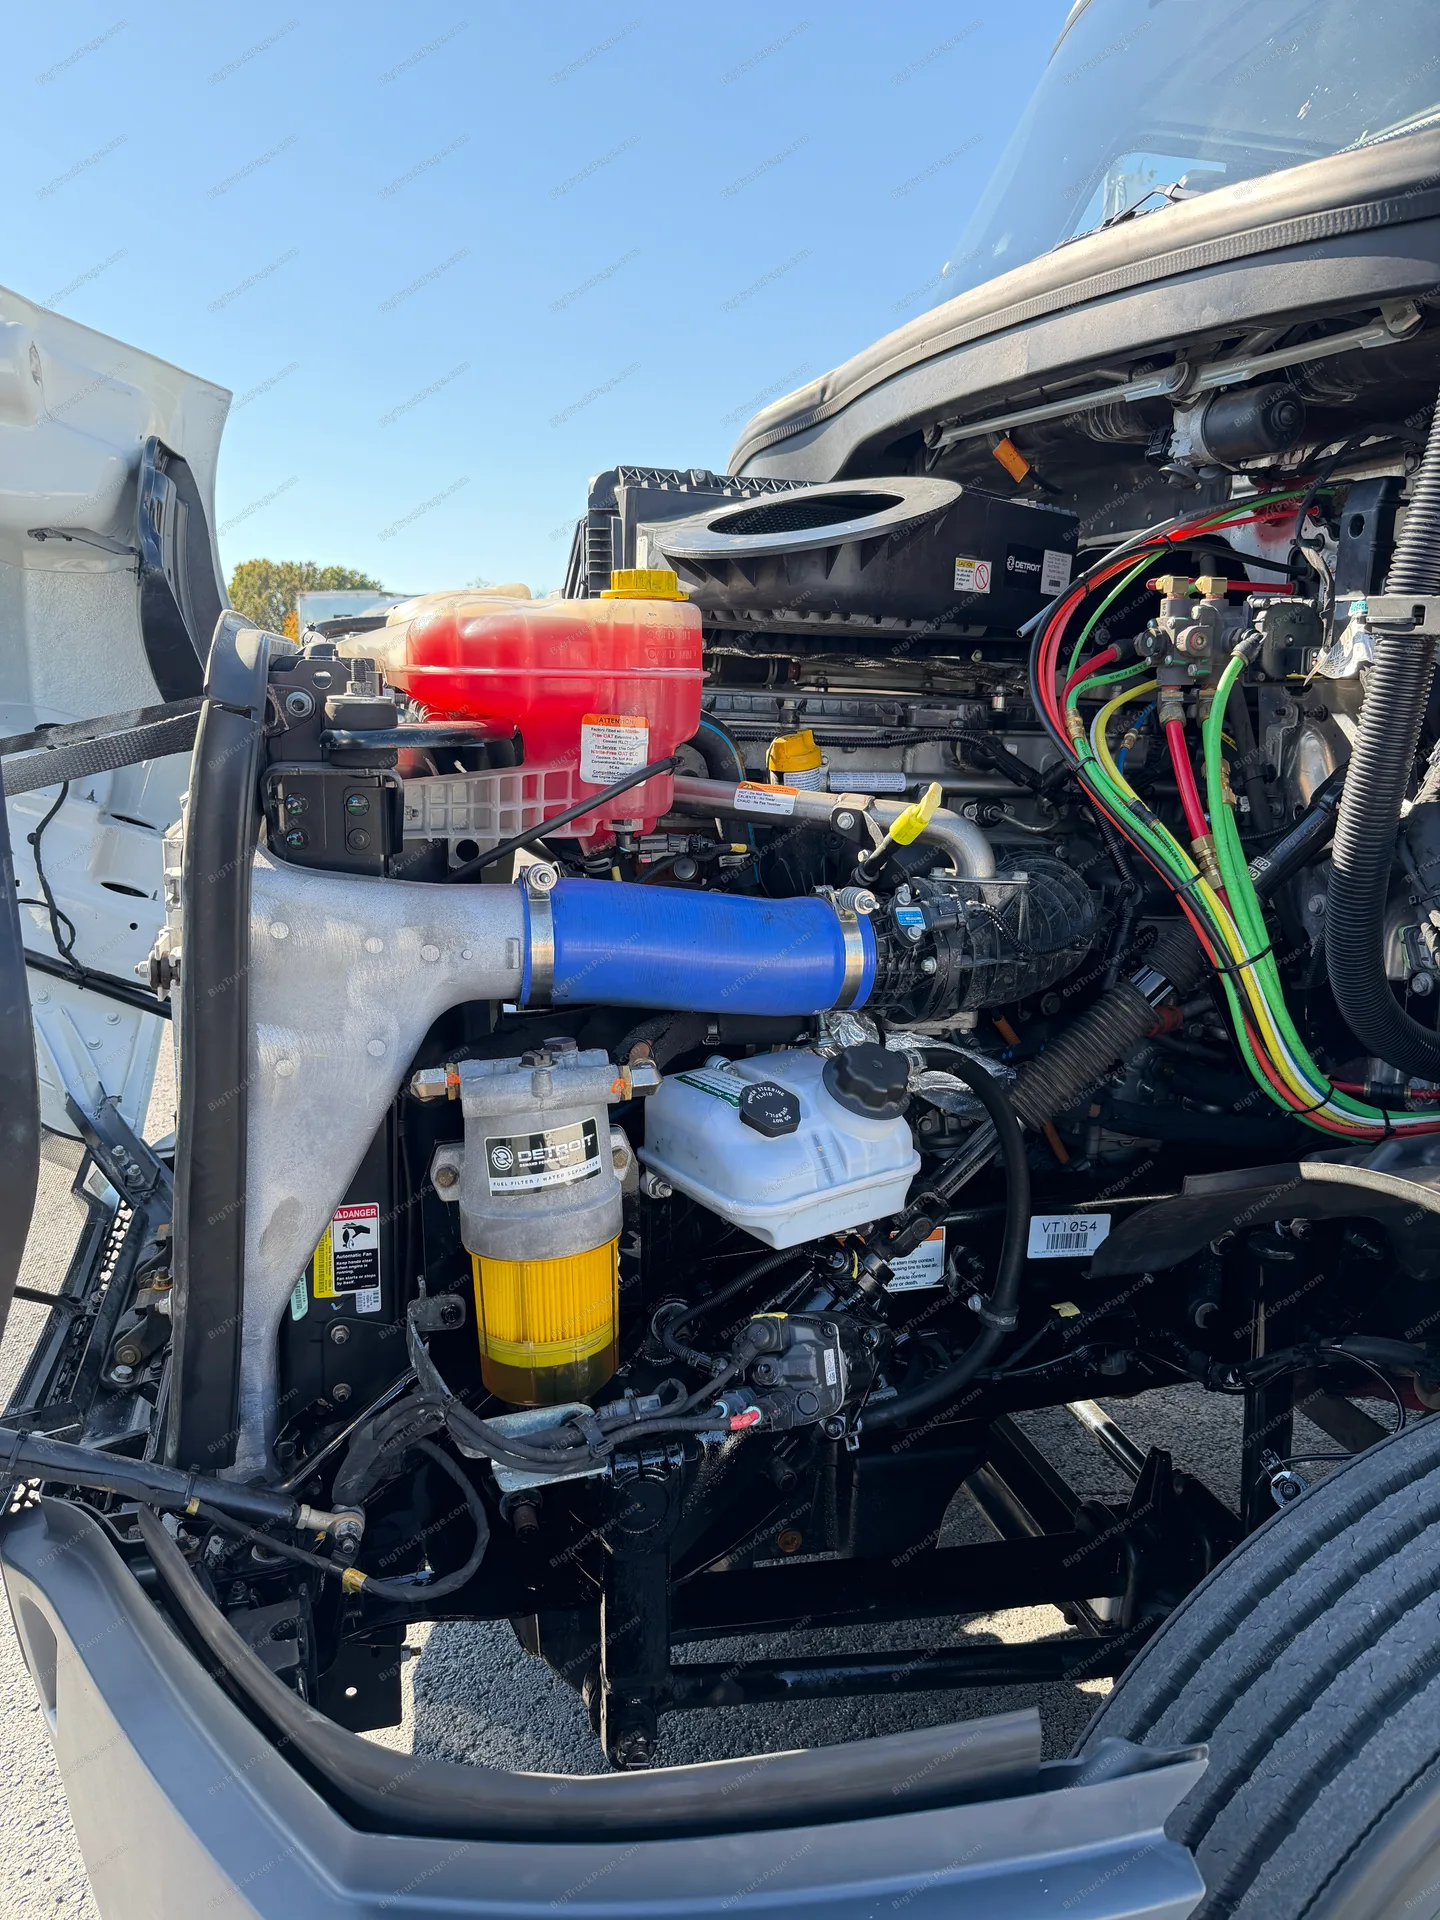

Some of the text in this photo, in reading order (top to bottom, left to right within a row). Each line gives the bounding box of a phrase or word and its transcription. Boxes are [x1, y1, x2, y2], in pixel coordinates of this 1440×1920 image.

[1015, 561, 1041, 572] DETROIT
[747, 1086, 785, 1104] POWER STEERING
[756, 1092, 773, 1100] FLUID
[765, 1106, 789, 1118] OVERFILL
[517, 1134, 594, 1162] DETROIT
[510, 1178, 534, 1186] FILTER
[567, 1161, 599, 1176] SEPARATOR
[342, 1208, 376, 1218] DANGER
[1042, 1220, 1098, 1233] VT1054
